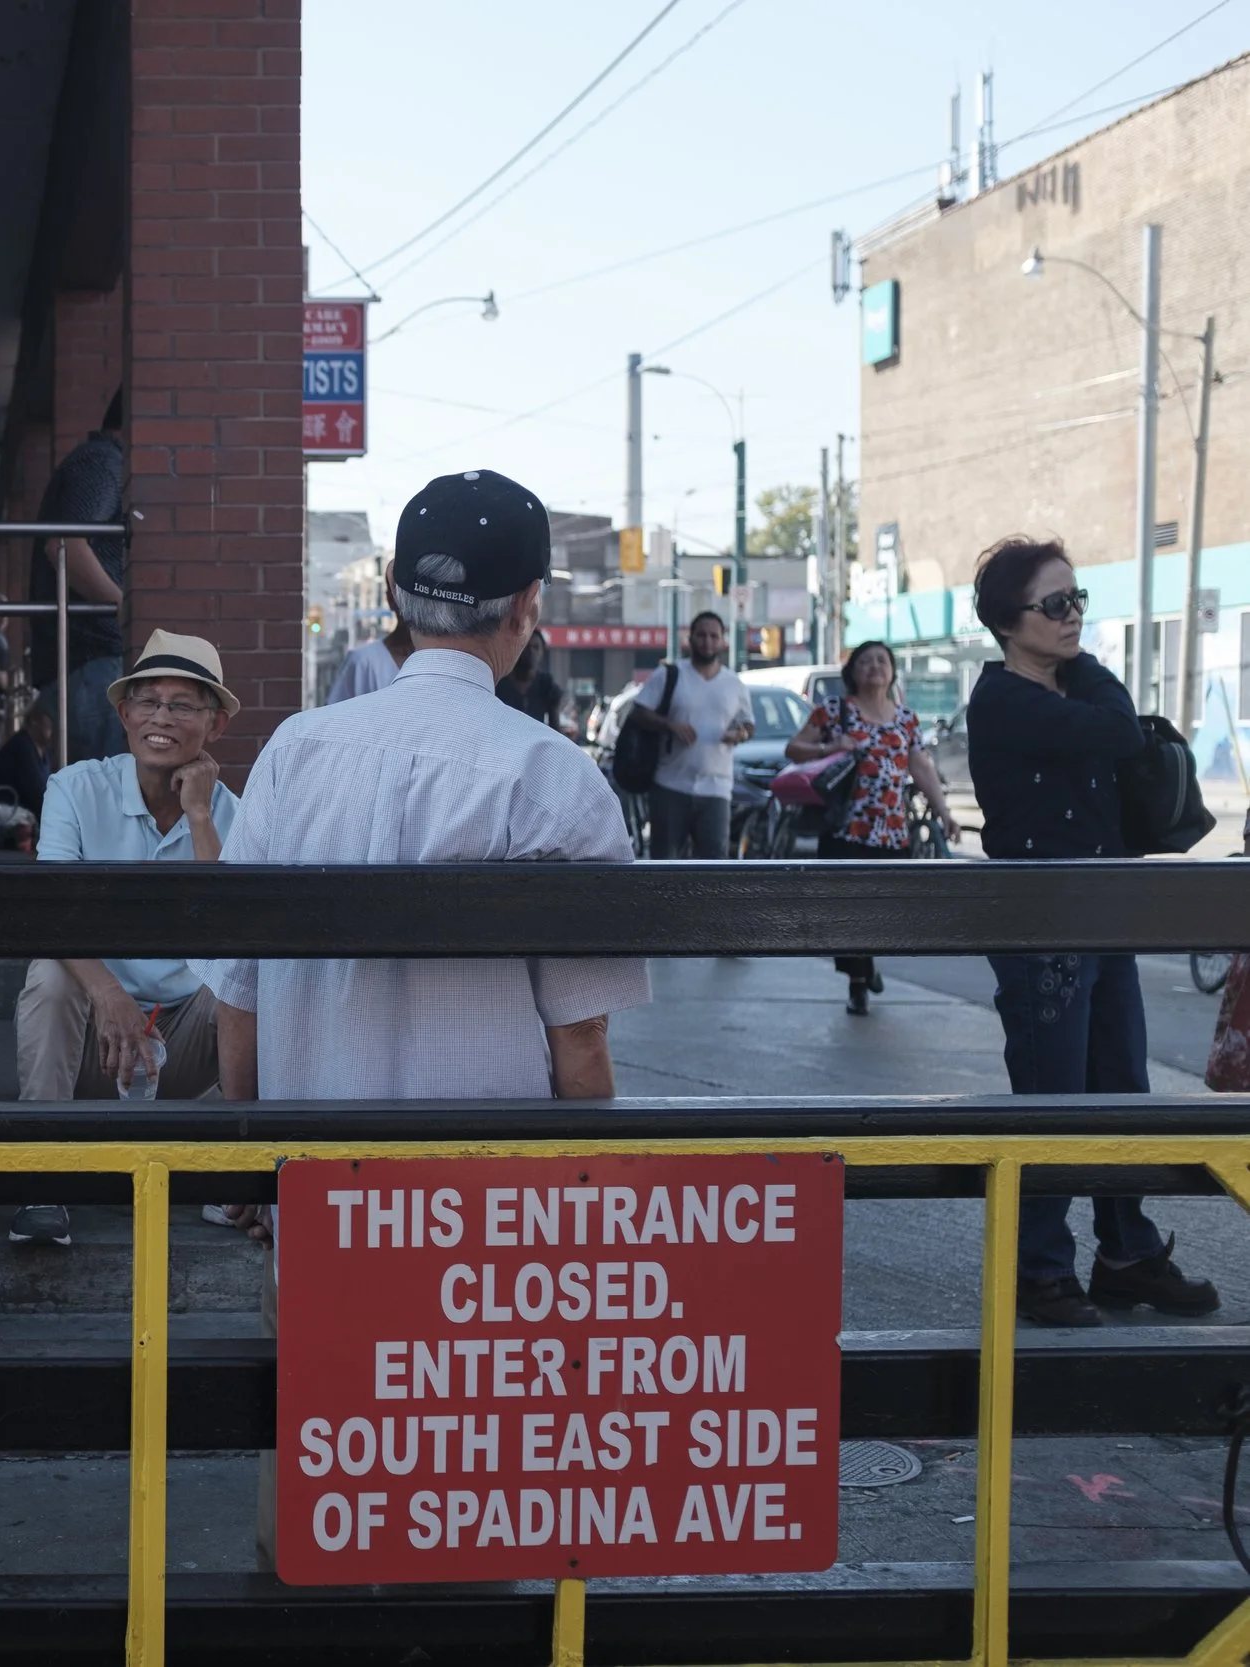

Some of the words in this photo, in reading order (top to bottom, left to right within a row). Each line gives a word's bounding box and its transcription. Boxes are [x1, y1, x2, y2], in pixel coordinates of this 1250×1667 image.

[414, 582, 429, 594] LOS
[432, 588, 475, 604] ANGELES
[328, 1188, 463, 1248] THIS
[485, 1184, 796, 1246] ENTRANCE
[441, 1261, 683, 1323] CLOSED.
[375, 1338, 566, 1399] ENTER
[587, 1335, 746, 1396] FROM
[299, 1414, 500, 1476] SOUTH
[522, 1411, 670, 1472] EAST
[688, 1408, 817, 1468] SIDE
[313, 1492, 388, 1550] OF
[408, 1486, 657, 1549] SPADINA
[675, 1483, 802, 1542] AVE.
